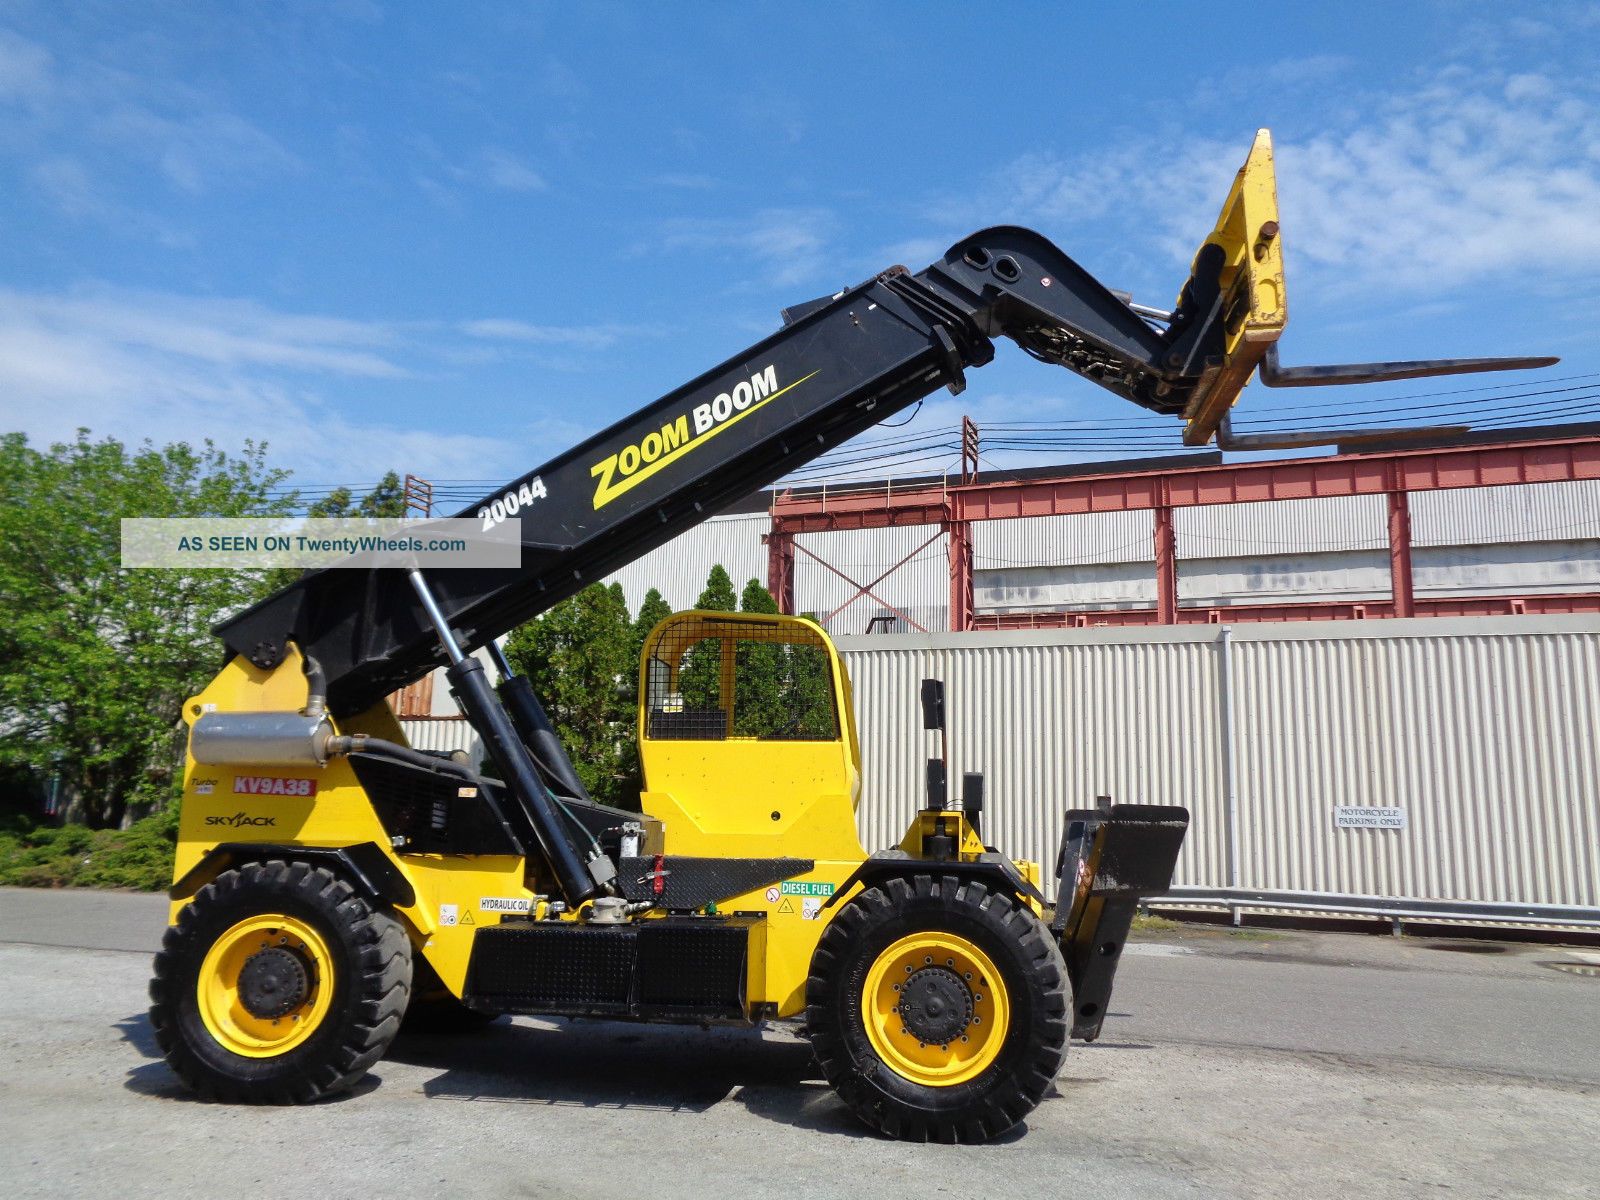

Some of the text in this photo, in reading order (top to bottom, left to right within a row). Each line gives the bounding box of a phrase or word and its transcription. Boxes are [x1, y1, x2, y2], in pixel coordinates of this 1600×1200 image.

[590, 364, 779, 511] ZOOM BOOM
[477, 474, 549, 533] 20044
[190, 778, 218, 786] Turbo
[1341, 808, 1399, 817] MOTORCYCLE
[204, 812, 276, 828] SKYJACK
[1339, 817, 1402, 826] PARKING ONLY
[782, 882, 833, 895] DIESEL FUEL
[481, 899, 529, 911] HYDRAULIC OIL
